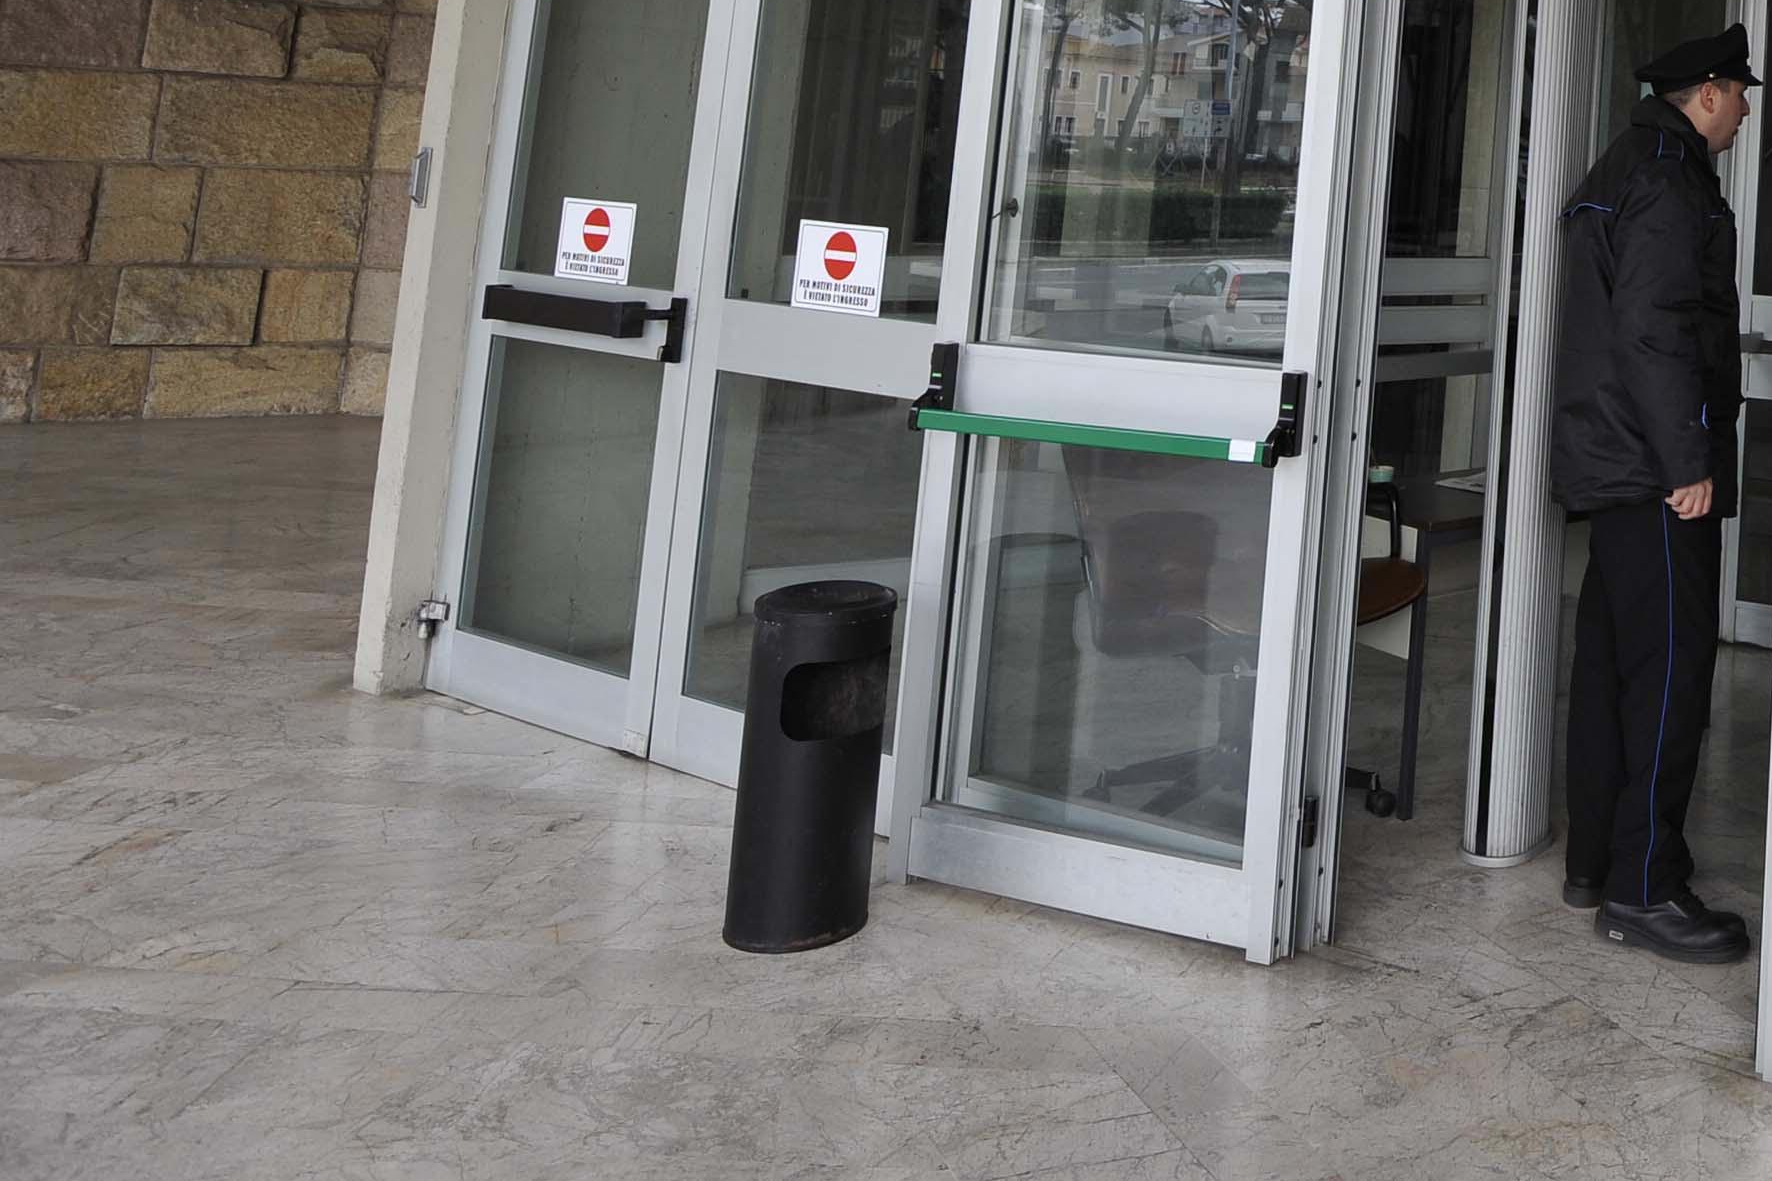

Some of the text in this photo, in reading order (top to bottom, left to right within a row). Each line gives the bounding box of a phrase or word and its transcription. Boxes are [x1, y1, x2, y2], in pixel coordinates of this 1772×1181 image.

[799, 279, 810, 288] PER
[834, 283, 841, 292] DI
[843, 284, 875, 296] SICUREZZA
